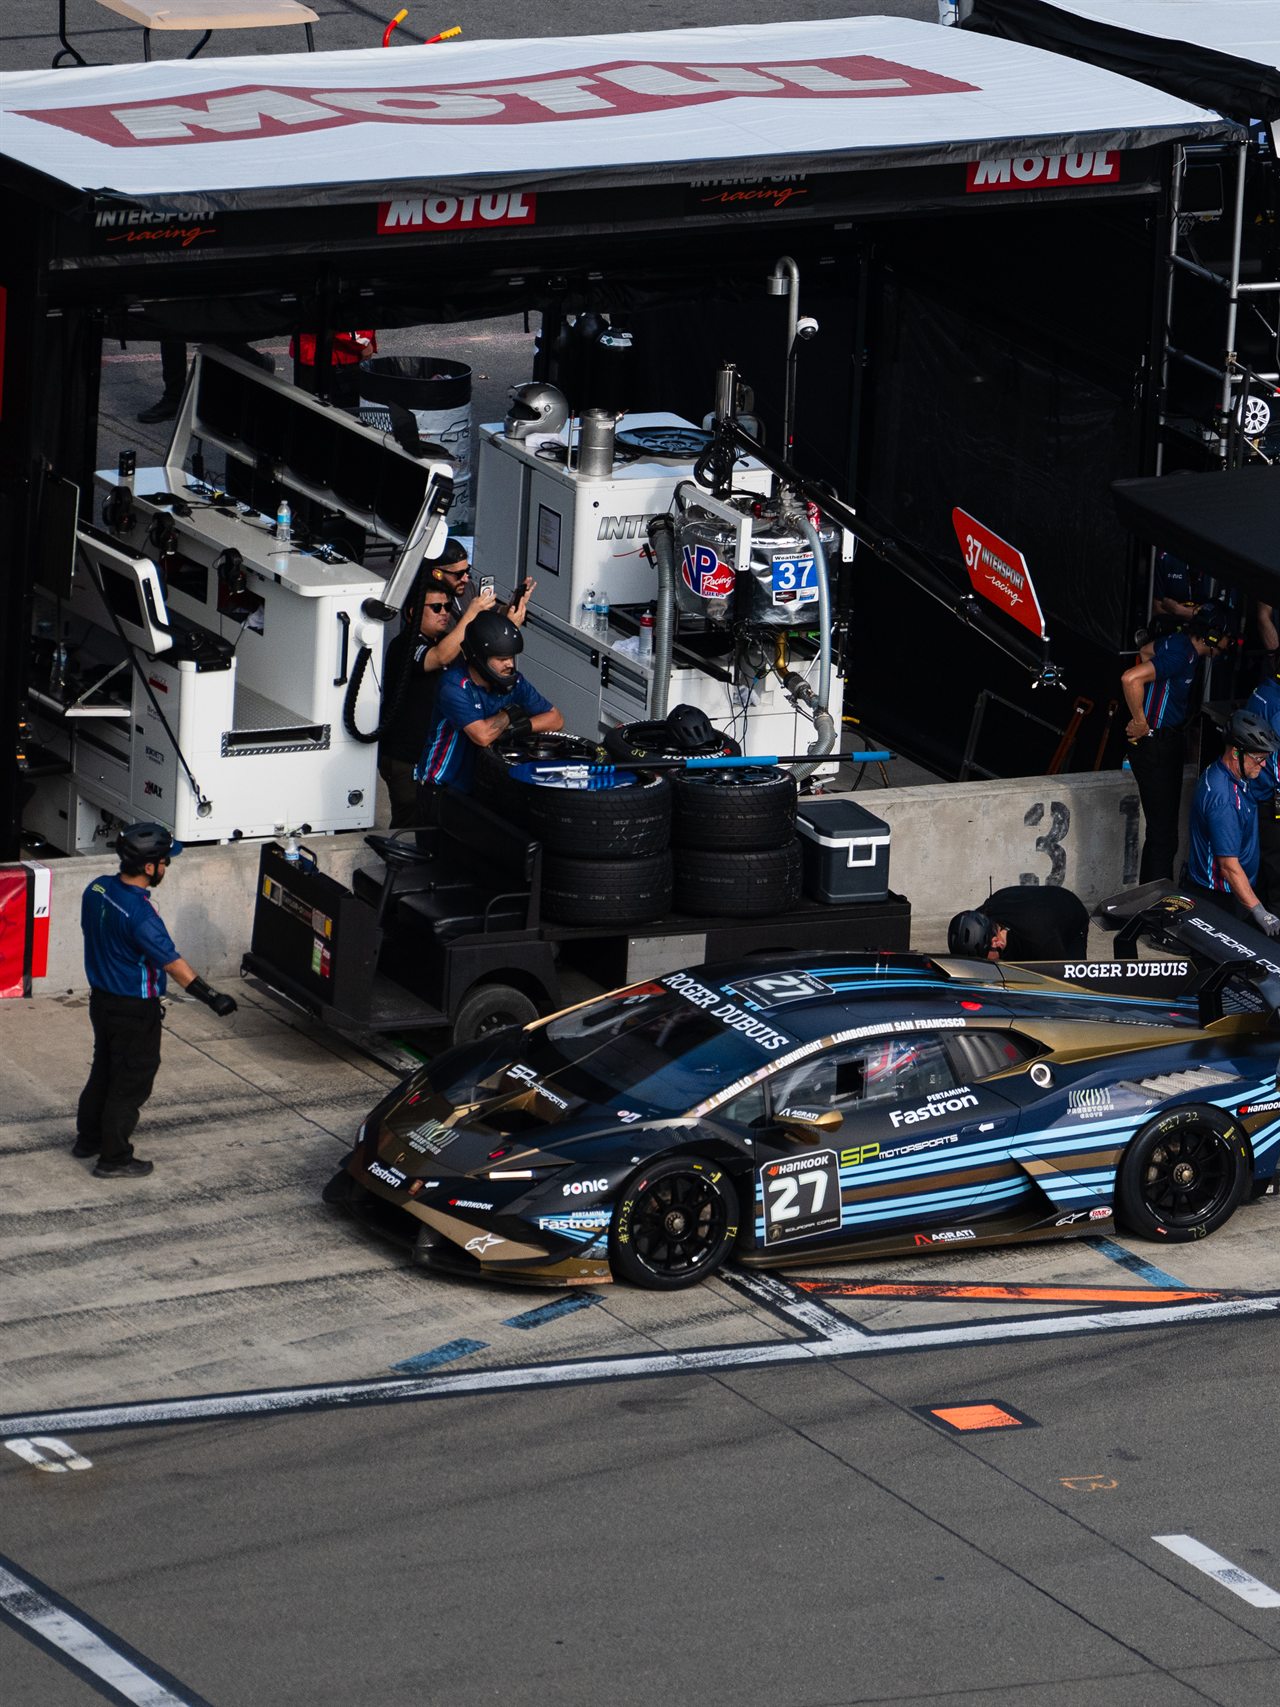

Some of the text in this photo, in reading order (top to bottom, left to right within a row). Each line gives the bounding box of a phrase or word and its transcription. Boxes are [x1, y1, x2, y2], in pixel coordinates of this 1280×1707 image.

[111, 64, 912, 140] MOTUL
[974, 151, 1114, 185] MOTUL
[384, 192, 529, 227] MOTUL
[106, 225, 216, 247] racing
[774, 552, 813, 562] WeatherTec
[965, 534, 1025, 591] 37 INTERSPORT
[702, 572, 735, 590] Racing
[778, 561, 814, 590] 37
[984, 574, 1023, 607] racing
[1188, 916, 1258, 959] SQUADRA
[1063, 961, 1189, 979] ROGER DUBUIS
[660, 972, 720, 1010] ROGER
[709, 1002, 790, 1051] DUBUIS
[830, 1016, 967, 1044] LAMBORGHINI SAN FRANCISCO
[506, 1063, 538, 1082] SP
[715, 1075, 753, 1104] MORILLO
[774, 1038, 824, 1070] CONWRIGHT
[926, 1085, 971, 1103] PERTAMINA
[888, 1093, 979, 1129] Fastron
[778, 1155, 829, 1175] HANKOOK
[840, 1133, 959, 1168] SP MOTORSPORTS
[366, 1160, 402, 1189] Fastron
[455, 1199, 494, 1211] HANKOOK
[768, 1170, 828, 1223] 27
[538, 1216, 612, 1230] Fastron
[571, 1209, 605, 1218] PERTAMINA
[931, 1228, 975, 1241] AGRATI
